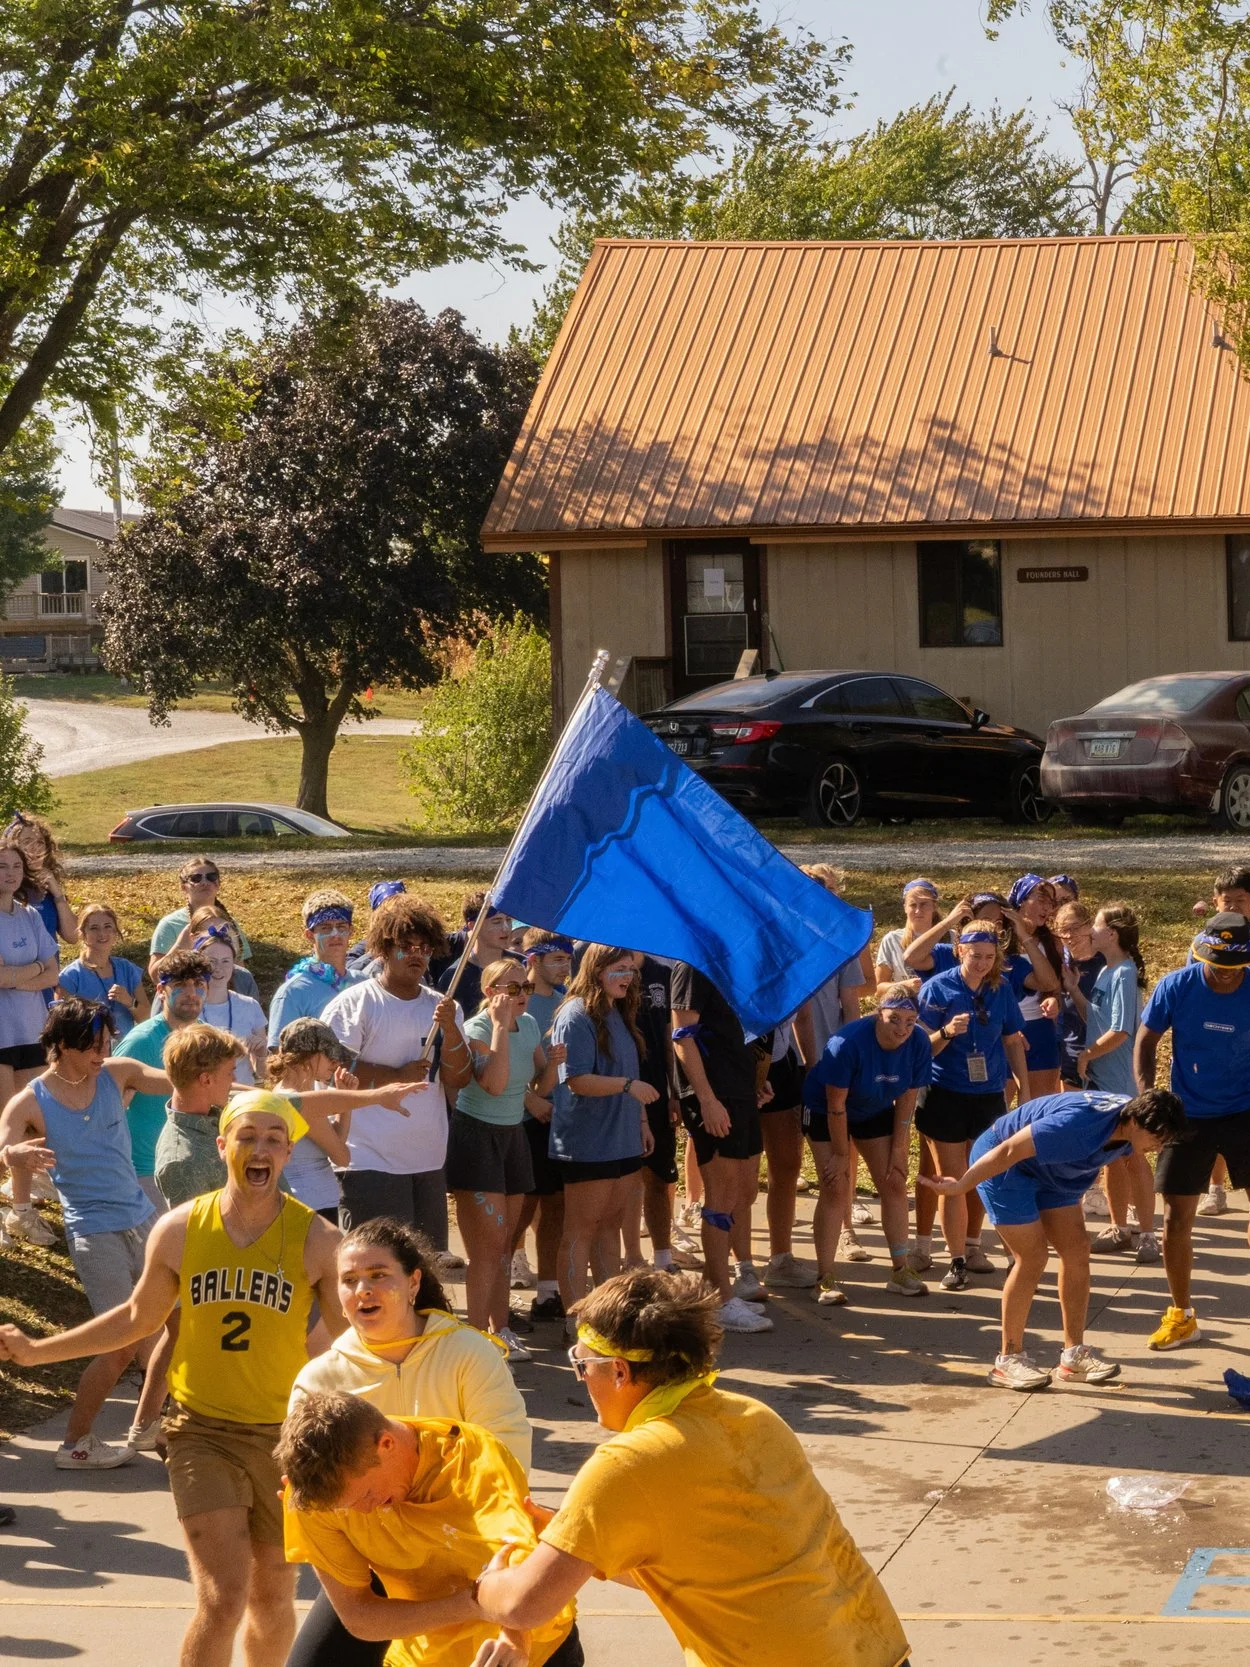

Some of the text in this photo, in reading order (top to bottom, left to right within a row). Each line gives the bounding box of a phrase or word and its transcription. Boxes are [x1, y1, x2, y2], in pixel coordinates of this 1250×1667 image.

[1026, 570, 1080, 579] FOUNDERS HALL
[190, 1267, 294, 1314] BALLERS
[221, 1311, 251, 1351] 2
